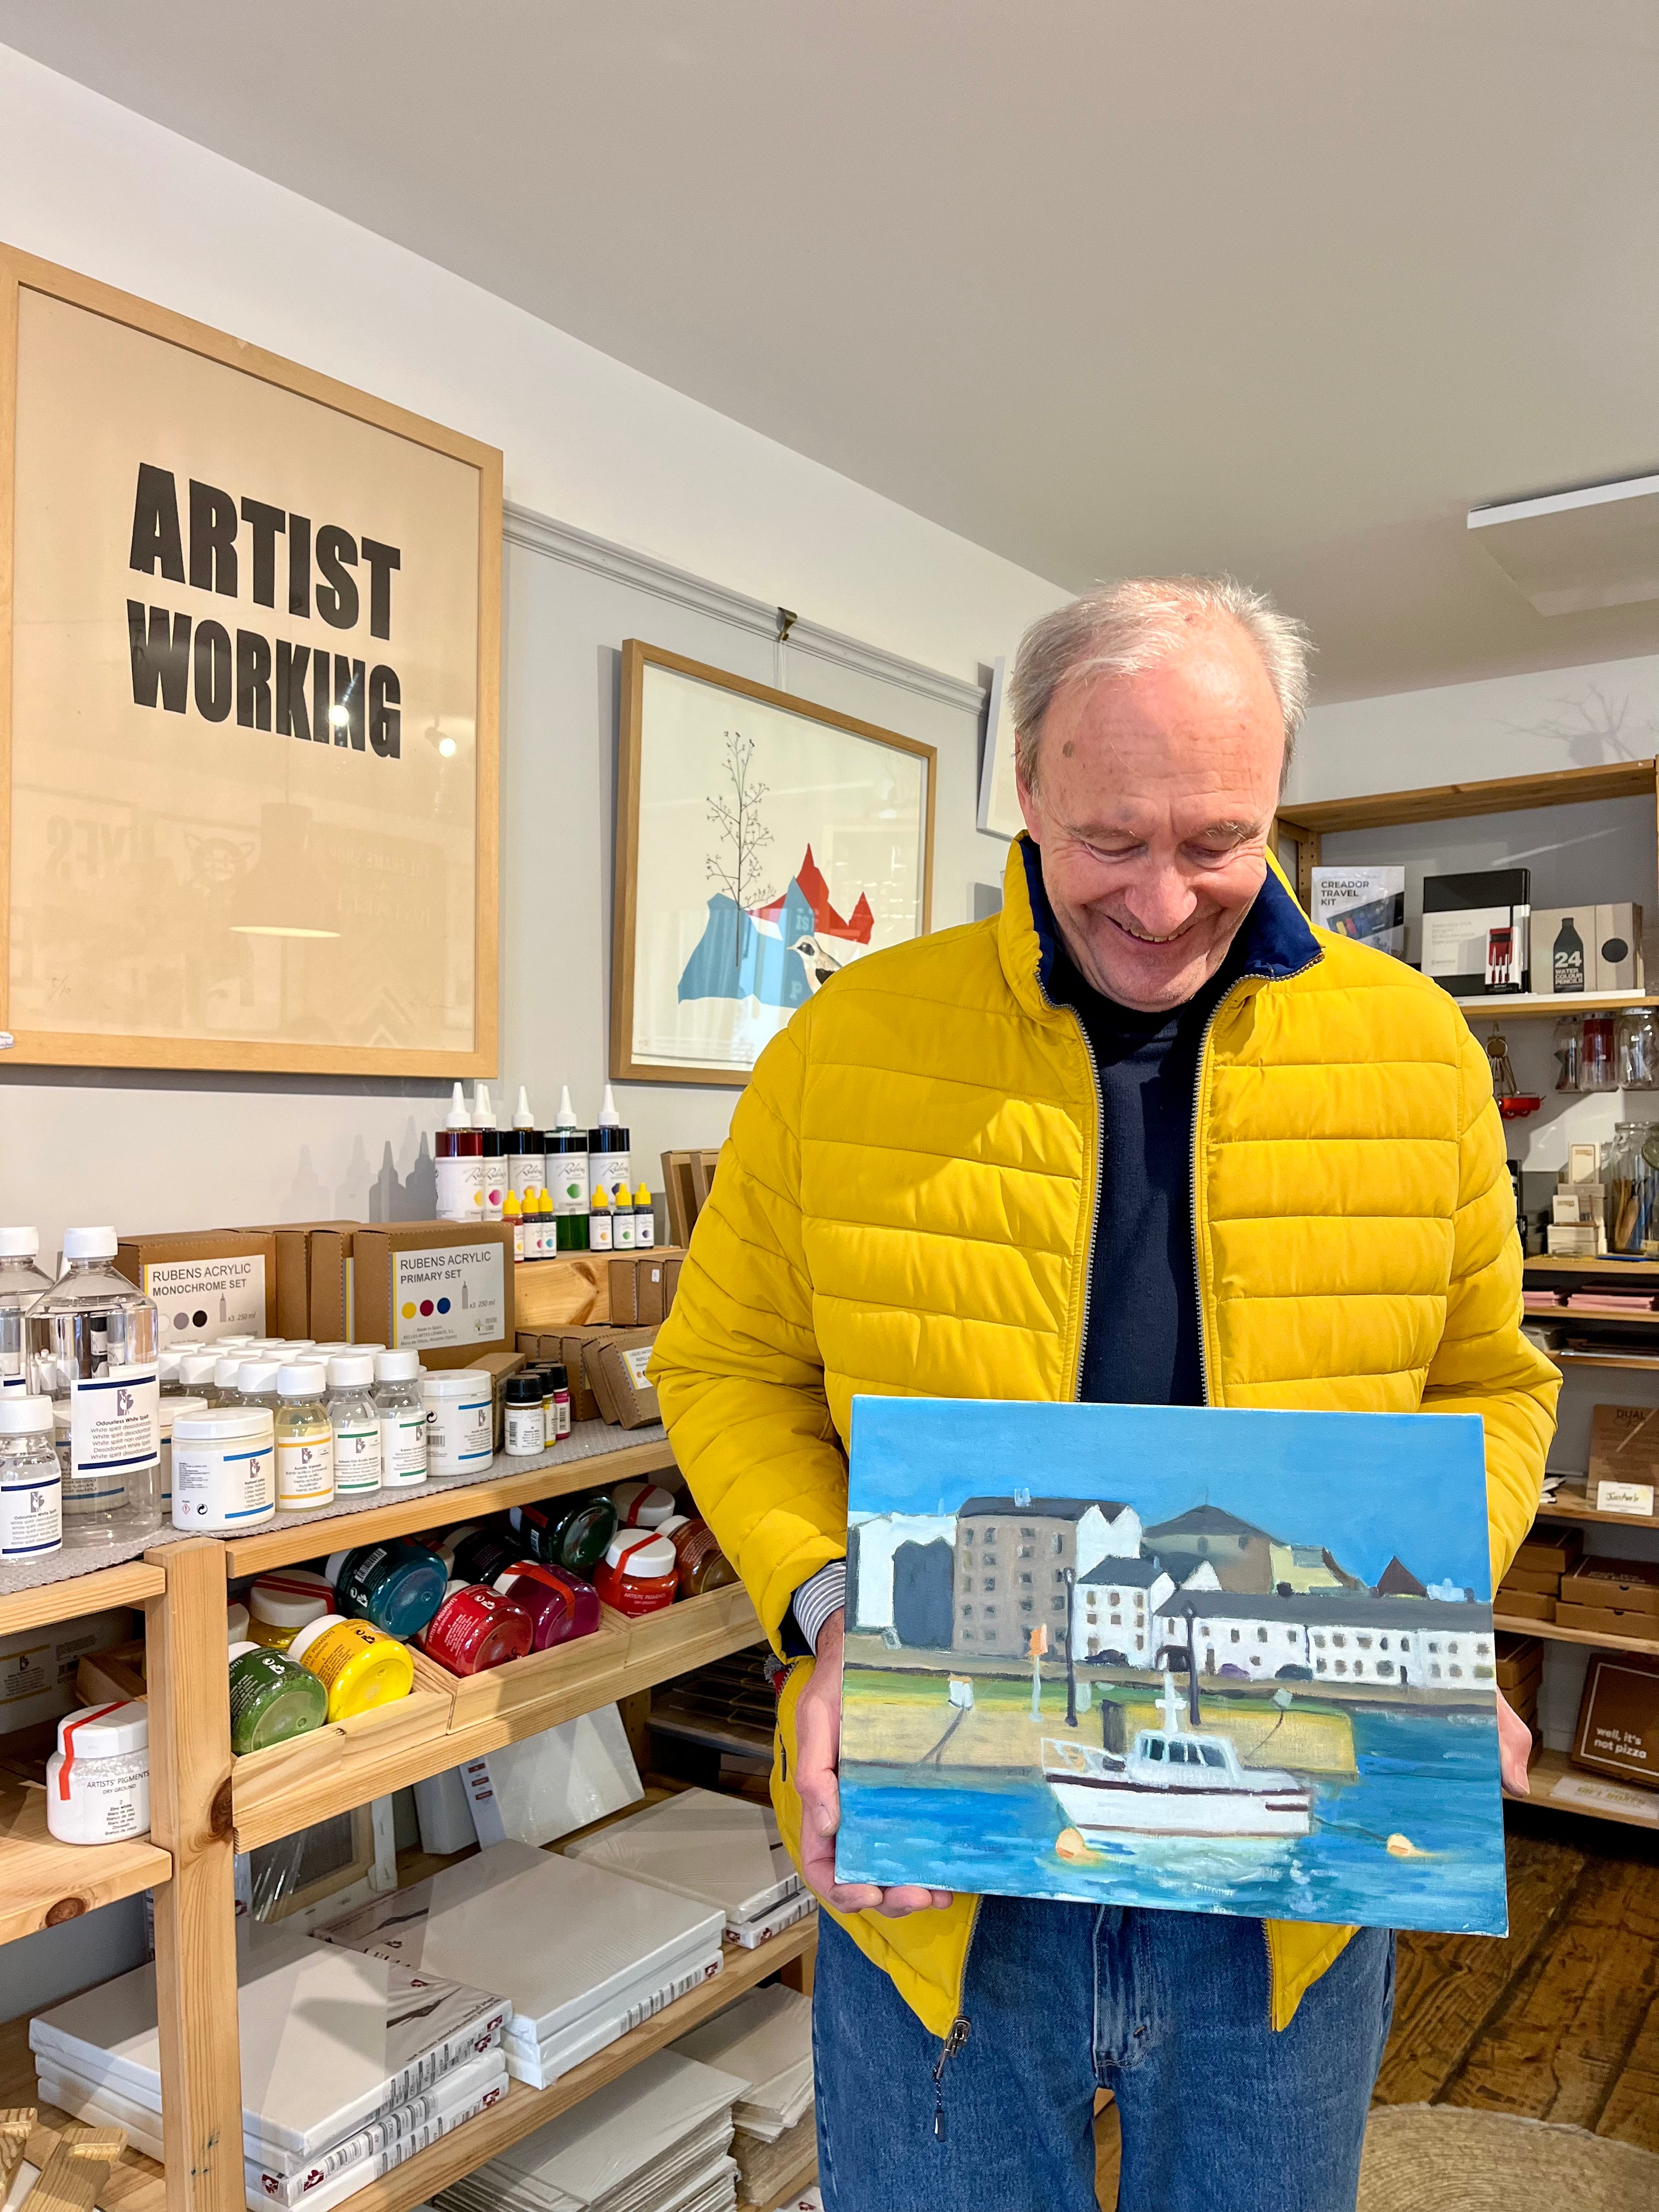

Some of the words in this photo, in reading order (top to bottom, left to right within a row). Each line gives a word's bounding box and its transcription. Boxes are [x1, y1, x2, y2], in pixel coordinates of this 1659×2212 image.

[130, 462, 400, 640] ARTIST
[127, 599, 400, 759] WORKING
[1555, 951, 1582, 968] 24
[514, 1164, 543, 1177] Rubens
[556, 1163, 585, 1177] Rubens
[600, 1163, 628, 1176] Rubens
[400, 1256, 445, 1270] RUBENS
[448, 1251, 491, 1263] ACRYLIC
[153, 1268, 201, 1282] RUBENS
[204, 1263, 251, 1277] ACRYLIC
[400, 1271, 442, 1284] PRIMARY
[445, 1269, 461, 1279] SET
[153, 1281, 227, 1296] MONOCHROME
[229, 1279, 247, 1289] SET
[437, 1597, 458, 1621] PIGMENTS
[311, 1630, 335, 1653] PIGMENTS
[314, 1642, 329, 1658] GROUND
[1596, 1727, 1621, 1742] well,
[1623, 1731, 1641, 1746] it's
[1594, 1739, 1613, 1751] not
[1615, 1743, 1647, 1759] pizza
[87, 1779, 116, 1788] ARTISTS'
[117, 1770, 150, 1784] PIGMENTS
[114, 1784, 136, 1792] GROUND
